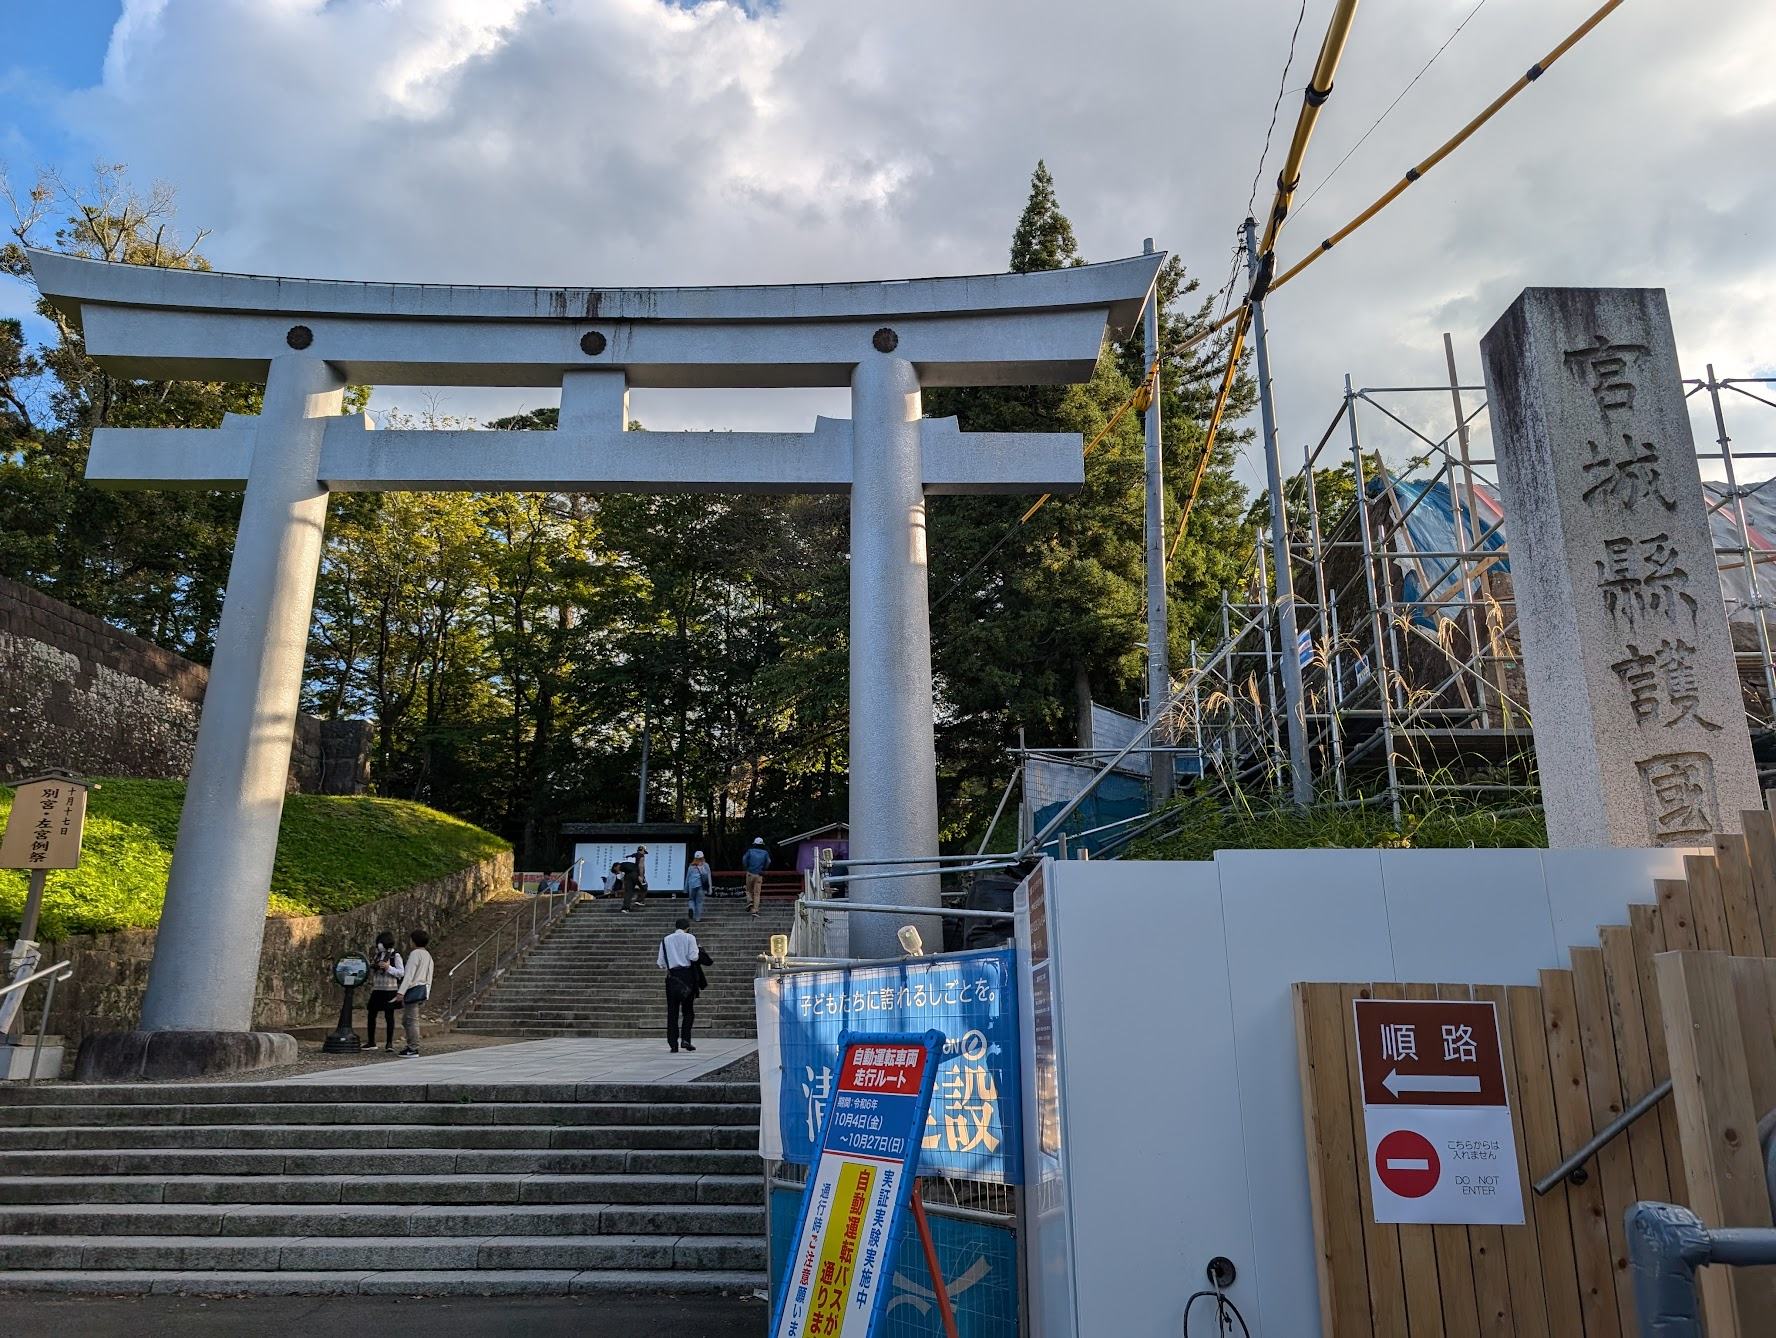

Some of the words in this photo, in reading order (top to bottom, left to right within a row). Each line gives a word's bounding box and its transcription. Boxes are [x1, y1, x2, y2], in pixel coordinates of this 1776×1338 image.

[27, 788, 60, 863] 別宮・左宮例祭
[60, 786, 77, 836] 十月十七日
[800, 977, 996, 1017] 子どもたちに誇れるしごとを。
[852, 1047, 920, 1069] 自動運転車両
[1379, 1023, 1478, 1062] 順路
[852, 1068, 908, 1089] 走行ルート
[834, 1112, 883, 1131] 10月4日(金)
[1447, 1140, 1500, 1150] こちらからは
[1452, 1150, 1497, 1160] 入れません
[1455, 1175, 1471, 1186] DO
[1478, 1175, 1500, 1186] NOT
[1462, 1186, 1496, 1196] ENTER
[824, 1168, 871, 1336] 自動運転バスが
[856, 1169, 895, 1310] 実証実験実施中
[788, 1183, 832, 1337] 通行時ご注意願いま
[807, 1260, 836, 1338] 通りま
